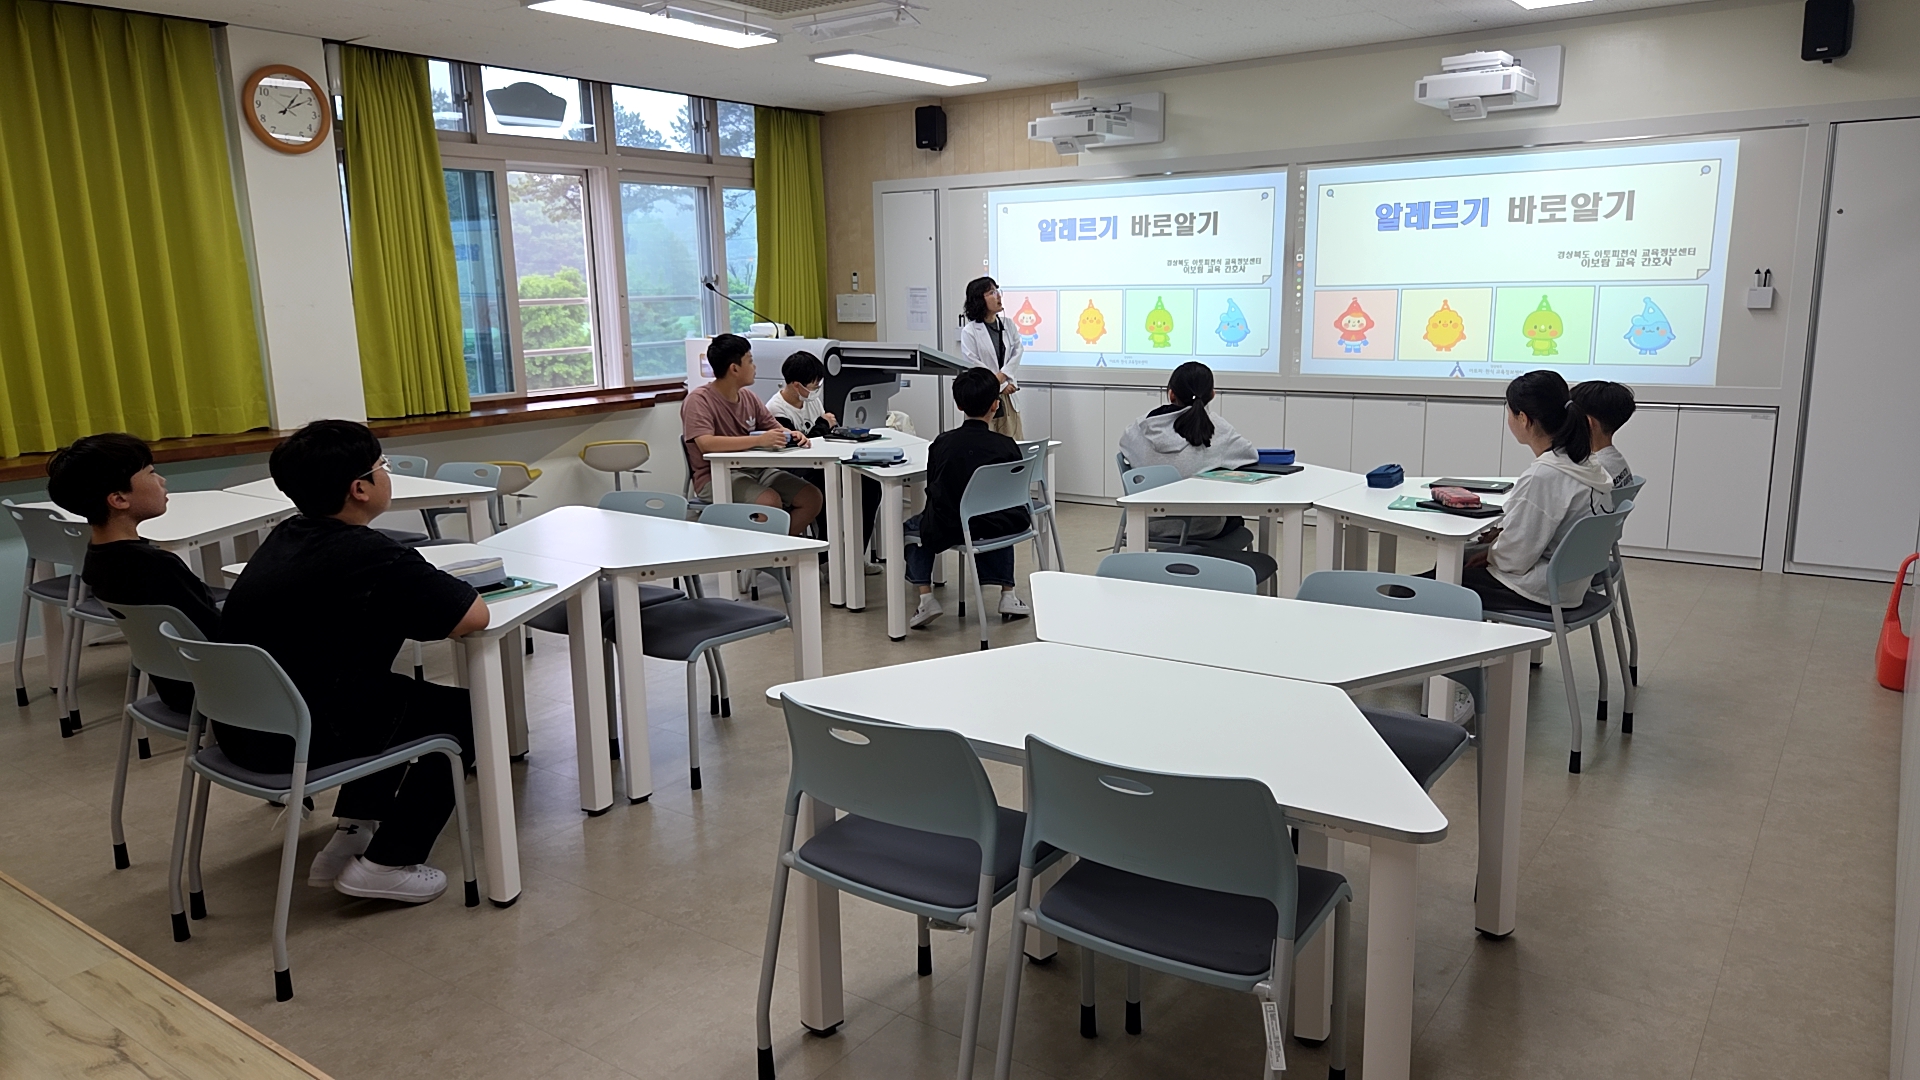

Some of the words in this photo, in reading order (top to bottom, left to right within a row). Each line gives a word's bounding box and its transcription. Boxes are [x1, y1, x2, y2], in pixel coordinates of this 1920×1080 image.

[1375, 197, 1489, 231] 알레르기
[1508, 190, 1636, 224] 바로알기
[1038, 215, 1118, 242] 알레르기
[1131, 211, 1218, 238] 바로알기
[1615, 257, 1636, 267] 교육
[1641, 256, 1672, 266] 간호사
[1642, 247, 1696, 257] 교육정보센터
